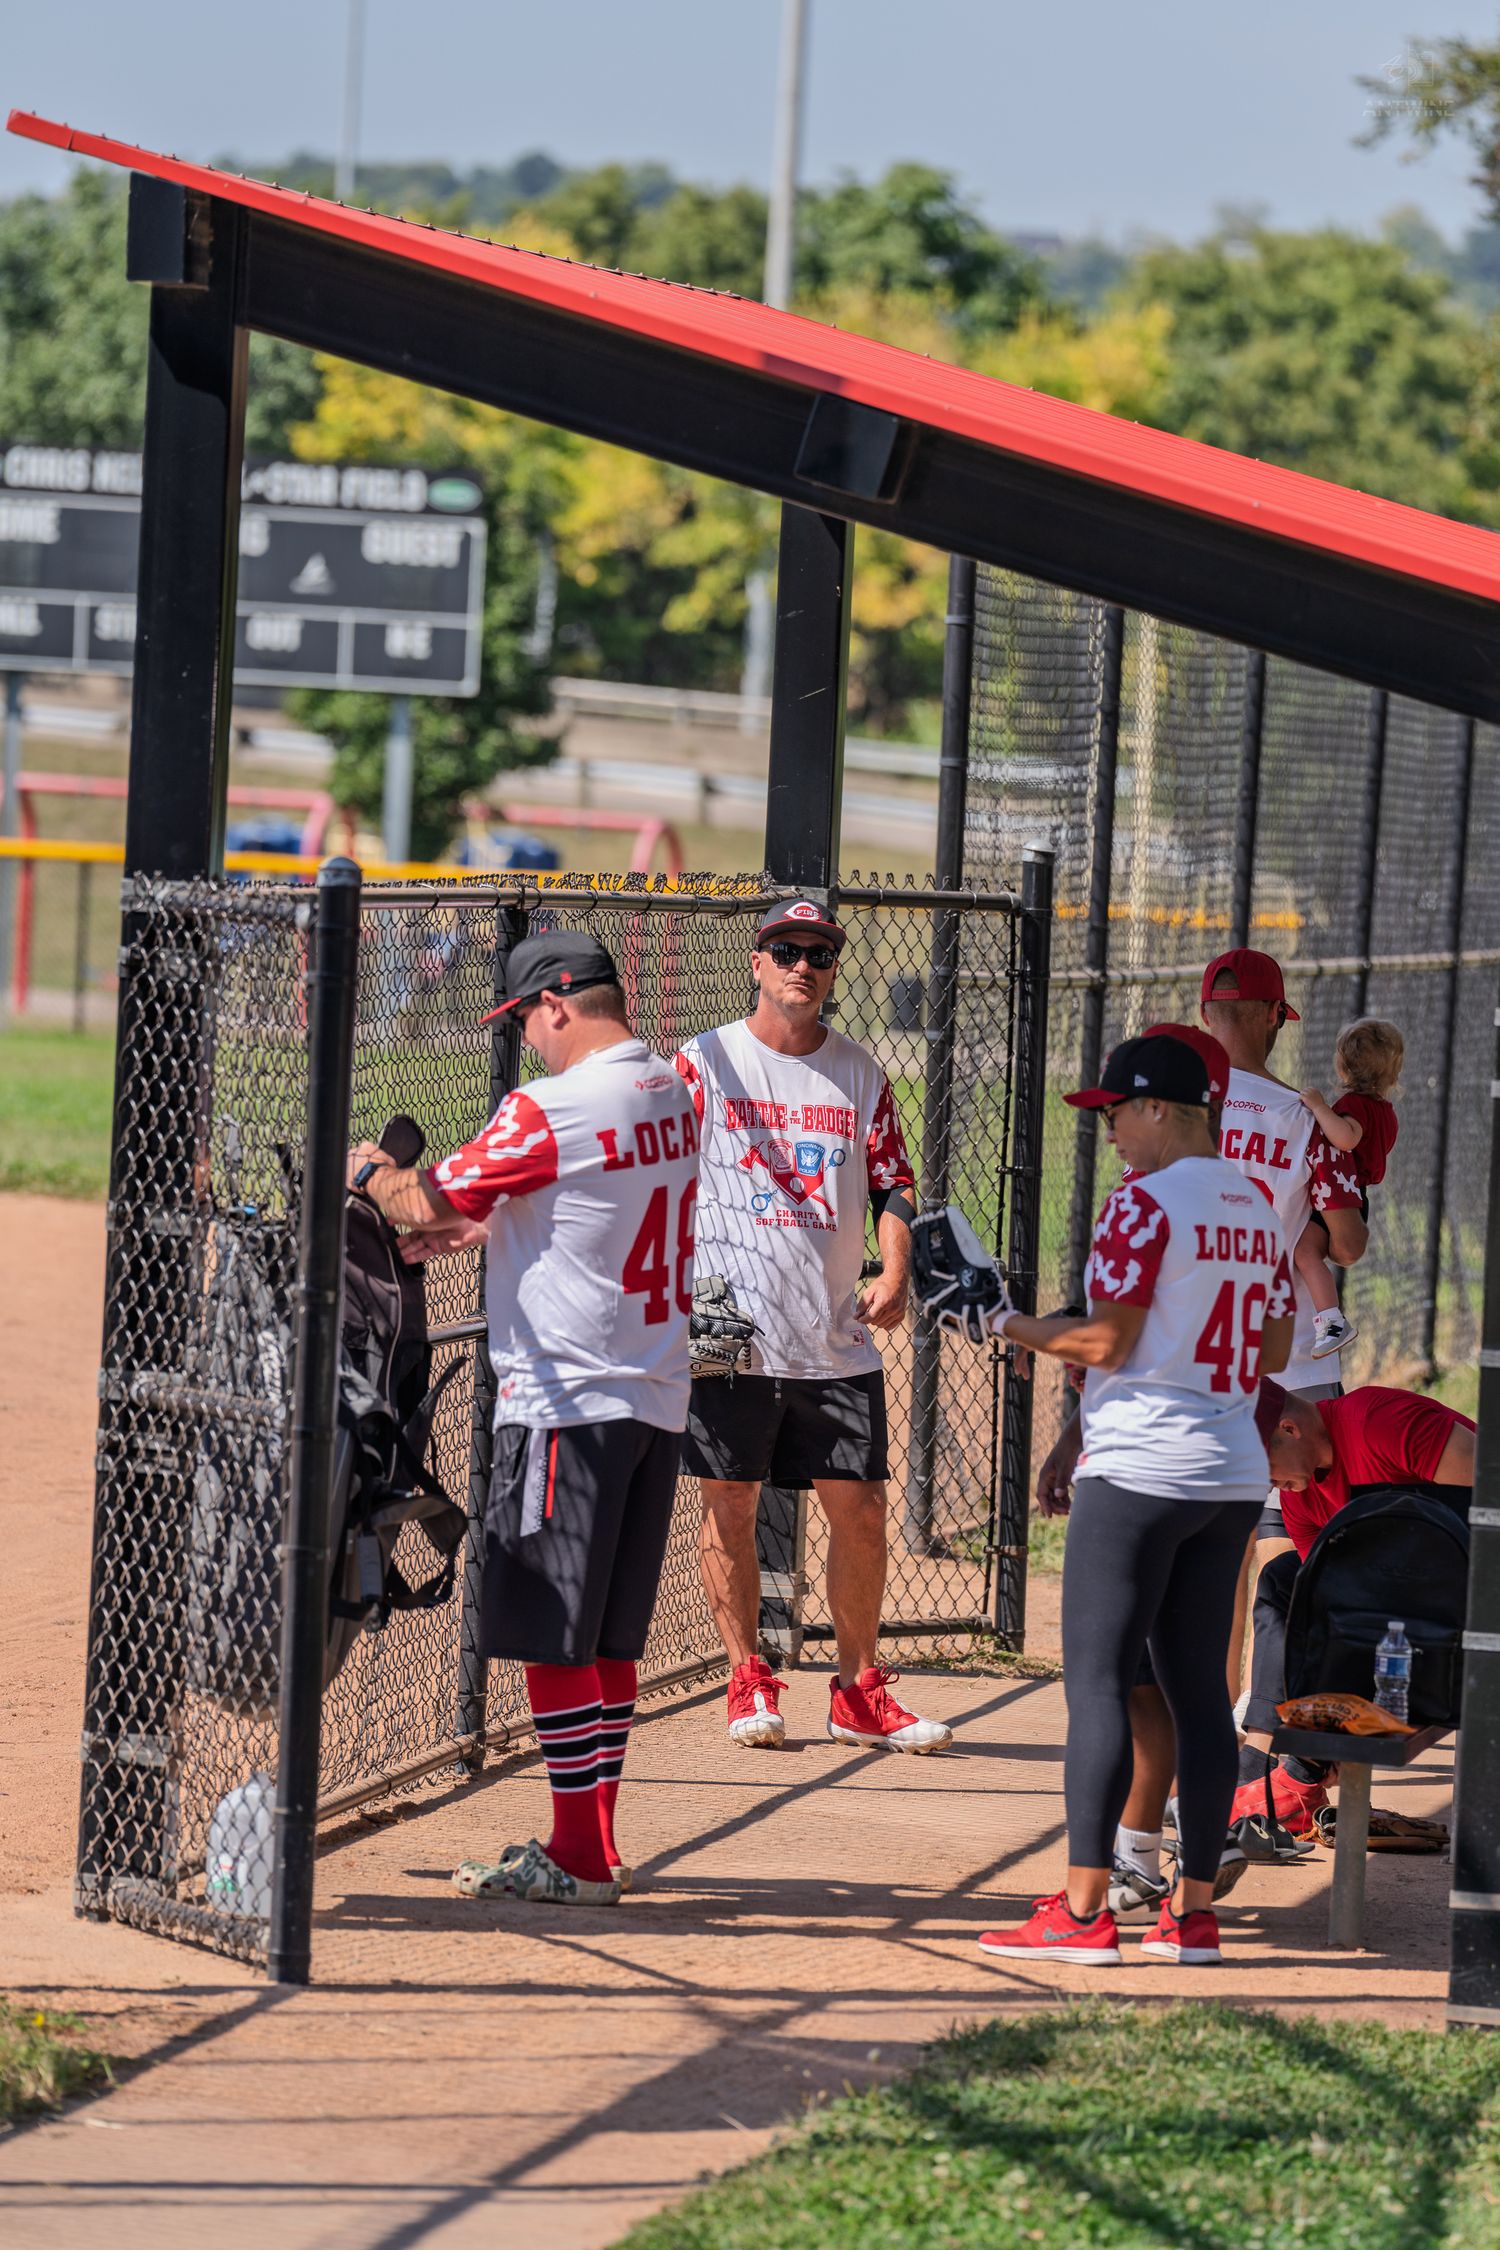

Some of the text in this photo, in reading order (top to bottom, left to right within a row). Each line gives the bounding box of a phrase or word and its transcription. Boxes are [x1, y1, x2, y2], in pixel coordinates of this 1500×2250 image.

[1232, 1100, 1267, 1113] COPFCU
[724, 1098, 788, 1132] BATTLE
[1218, 1128, 1293, 1170] CAL
[776, 1210, 820, 1220] CHARITY
[756, 1217, 837, 1232] SOFTBALL GAME
